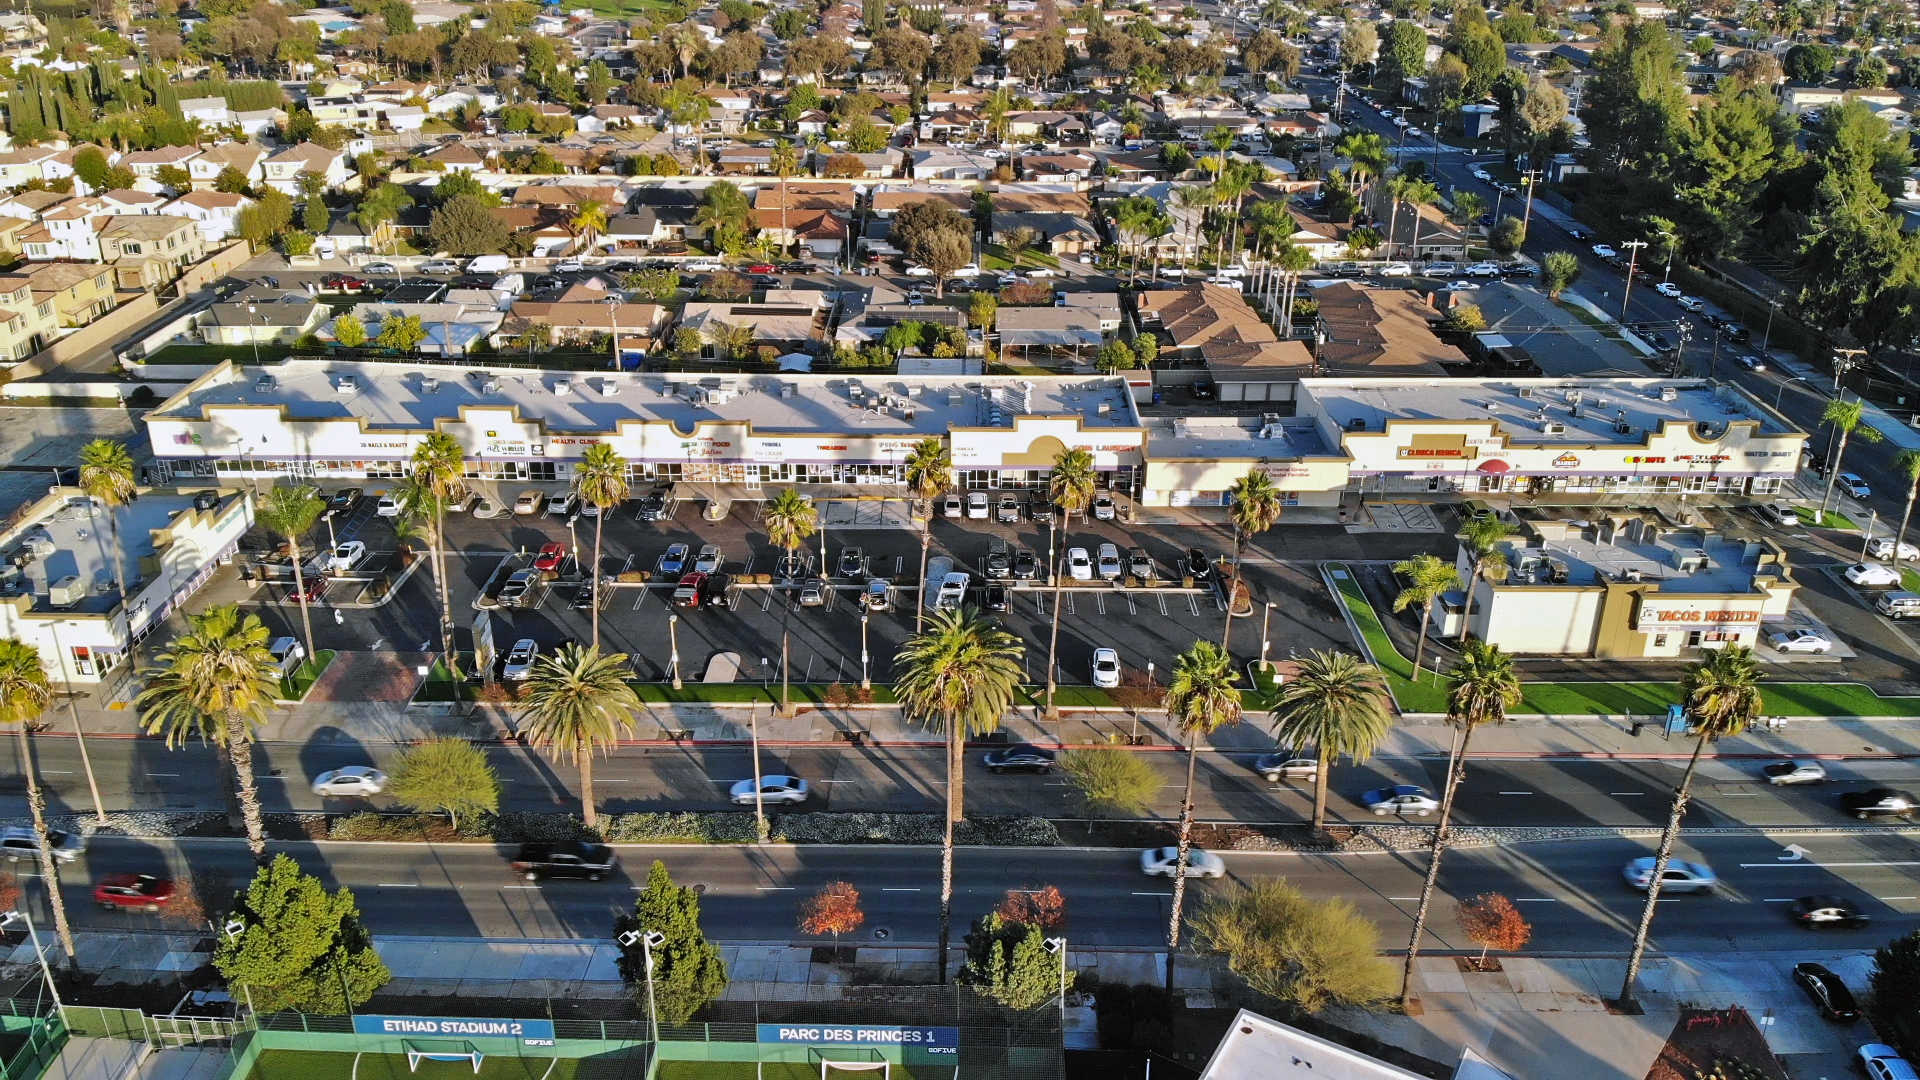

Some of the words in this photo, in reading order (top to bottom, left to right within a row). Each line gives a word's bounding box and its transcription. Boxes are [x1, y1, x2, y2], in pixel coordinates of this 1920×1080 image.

[1096, 444, 1136, 452] LAUNDRY
[1657, 610, 1701, 621] TACOS
[1703, 610, 1760, 622] MEXICO
[383, 1020, 438, 1033] ETIHAD
[441, 1021, 507, 1034] STADIUM
[510, 1023, 523, 1035] 2
[779, 1028, 820, 1041] PARC
[823, 1029, 854, 1041] DES
[857, 1030, 922, 1042] PRINCES
[925, 1031, 936, 1043] 1
